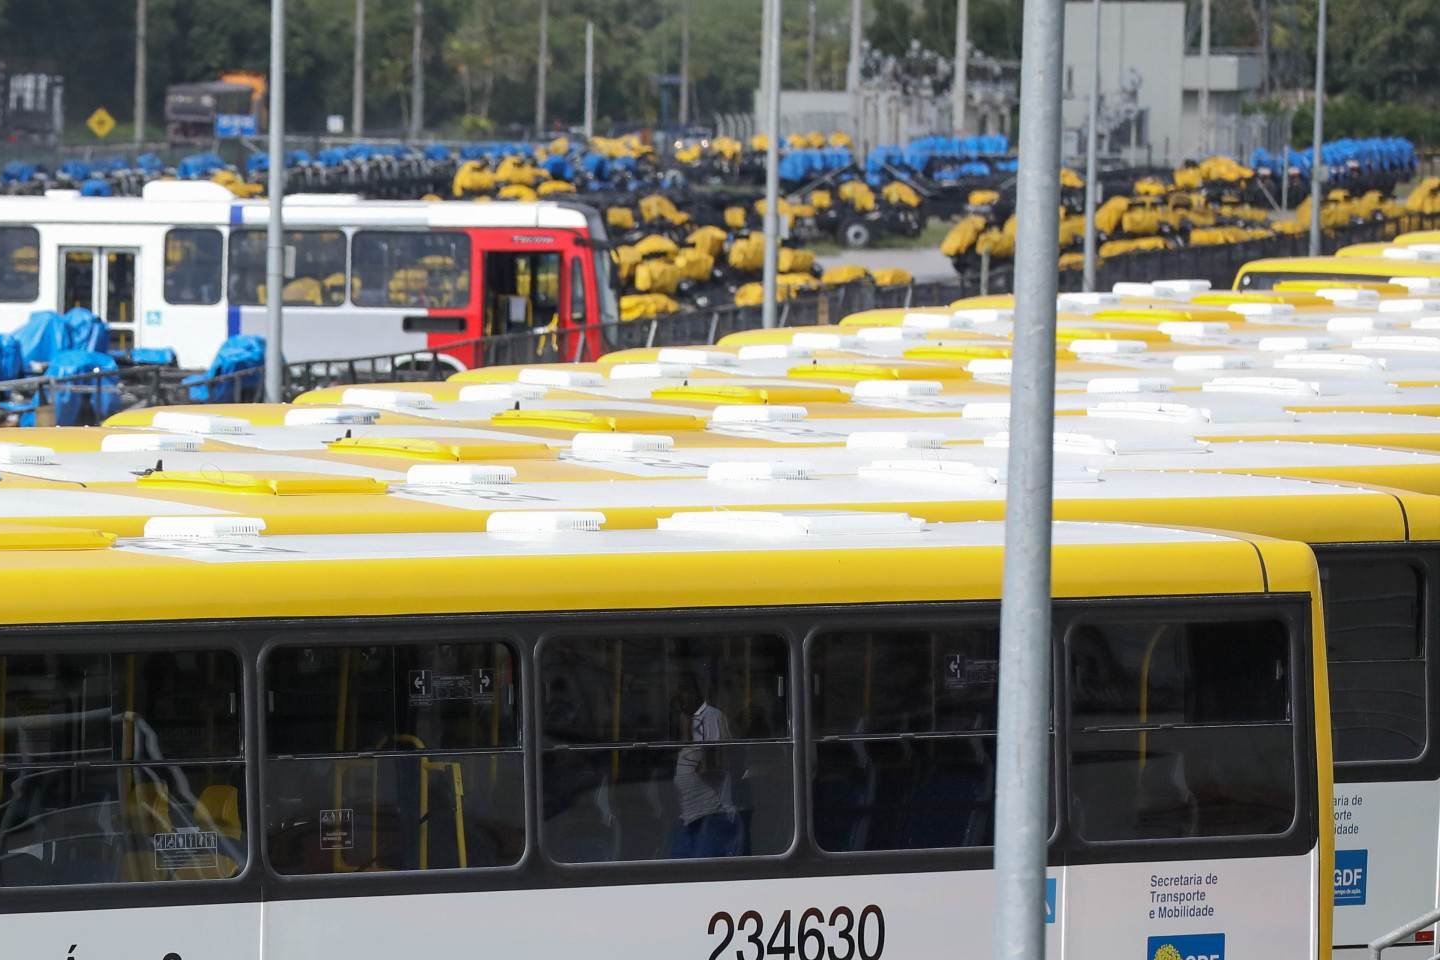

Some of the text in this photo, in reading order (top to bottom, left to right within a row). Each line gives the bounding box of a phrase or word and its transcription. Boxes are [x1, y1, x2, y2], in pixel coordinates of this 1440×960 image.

[1333, 794, 1363, 806] aria de
[1334, 810, 1352, 820] orte
[1334, 823, 1359, 835] idade
[1150, 873, 1218, 888] Secretaria de
[1333, 868, 1363, 887] GDF
[1150, 890, 1206, 905] Transporte
[1149, 905, 1214, 919] e Mobilidade
